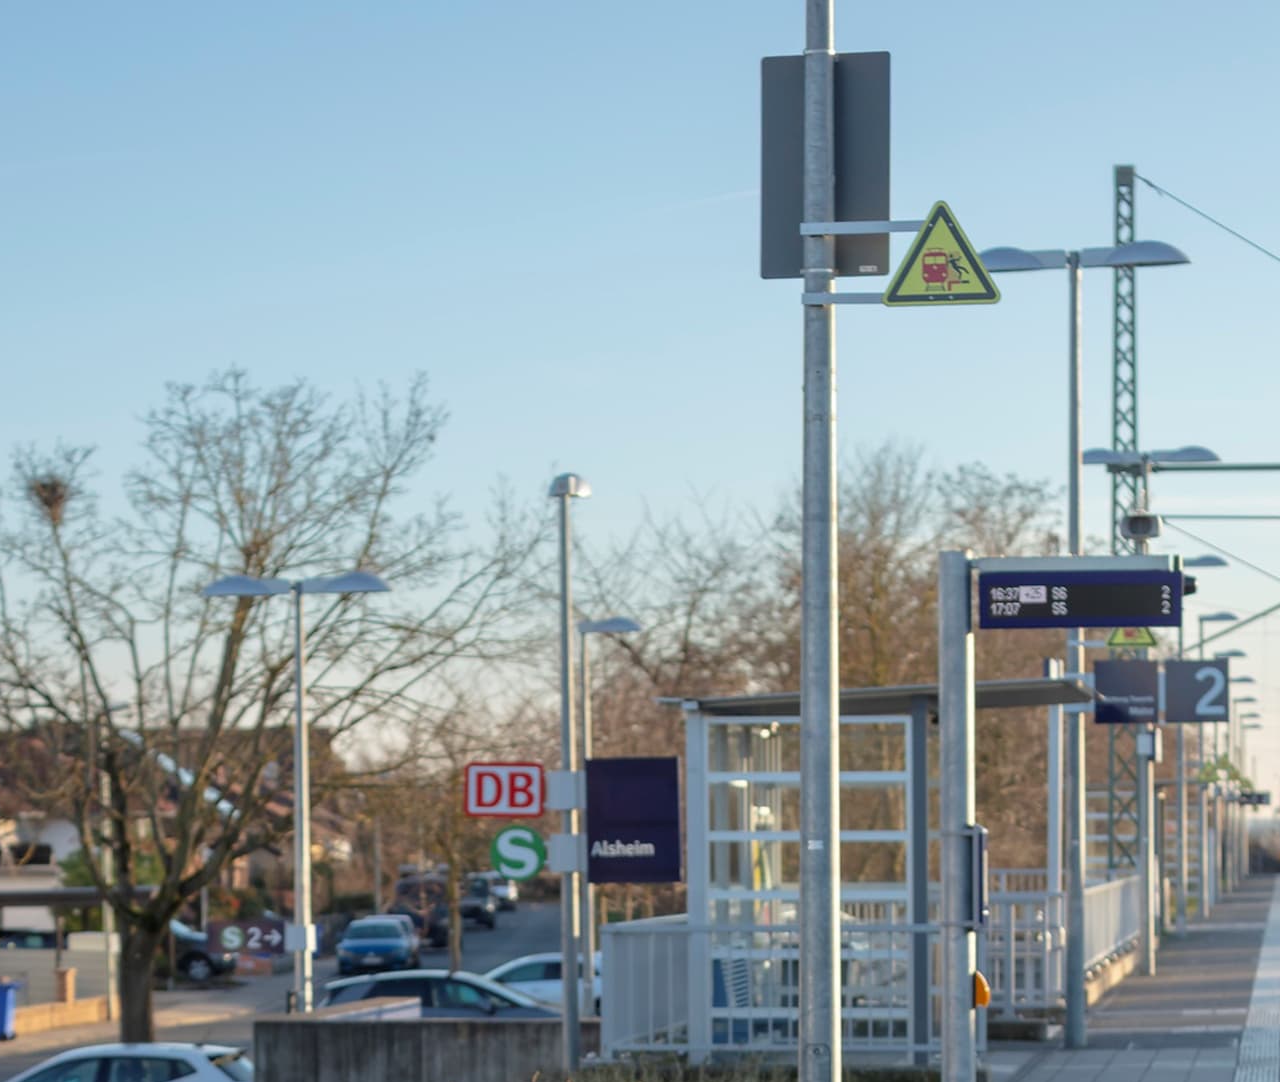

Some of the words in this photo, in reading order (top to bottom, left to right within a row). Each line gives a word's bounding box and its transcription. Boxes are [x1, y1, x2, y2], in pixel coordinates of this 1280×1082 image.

[1161, 585, 1171, 599] 2
[1161, 601, 1171, 614] 2
[1195, 666, 1225, 715] 2
[475, 771, 535, 808] DB
[496, 828, 540, 879] S
[591, 840, 655, 858] Alsheim
[246, 926, 262, 949] 2
